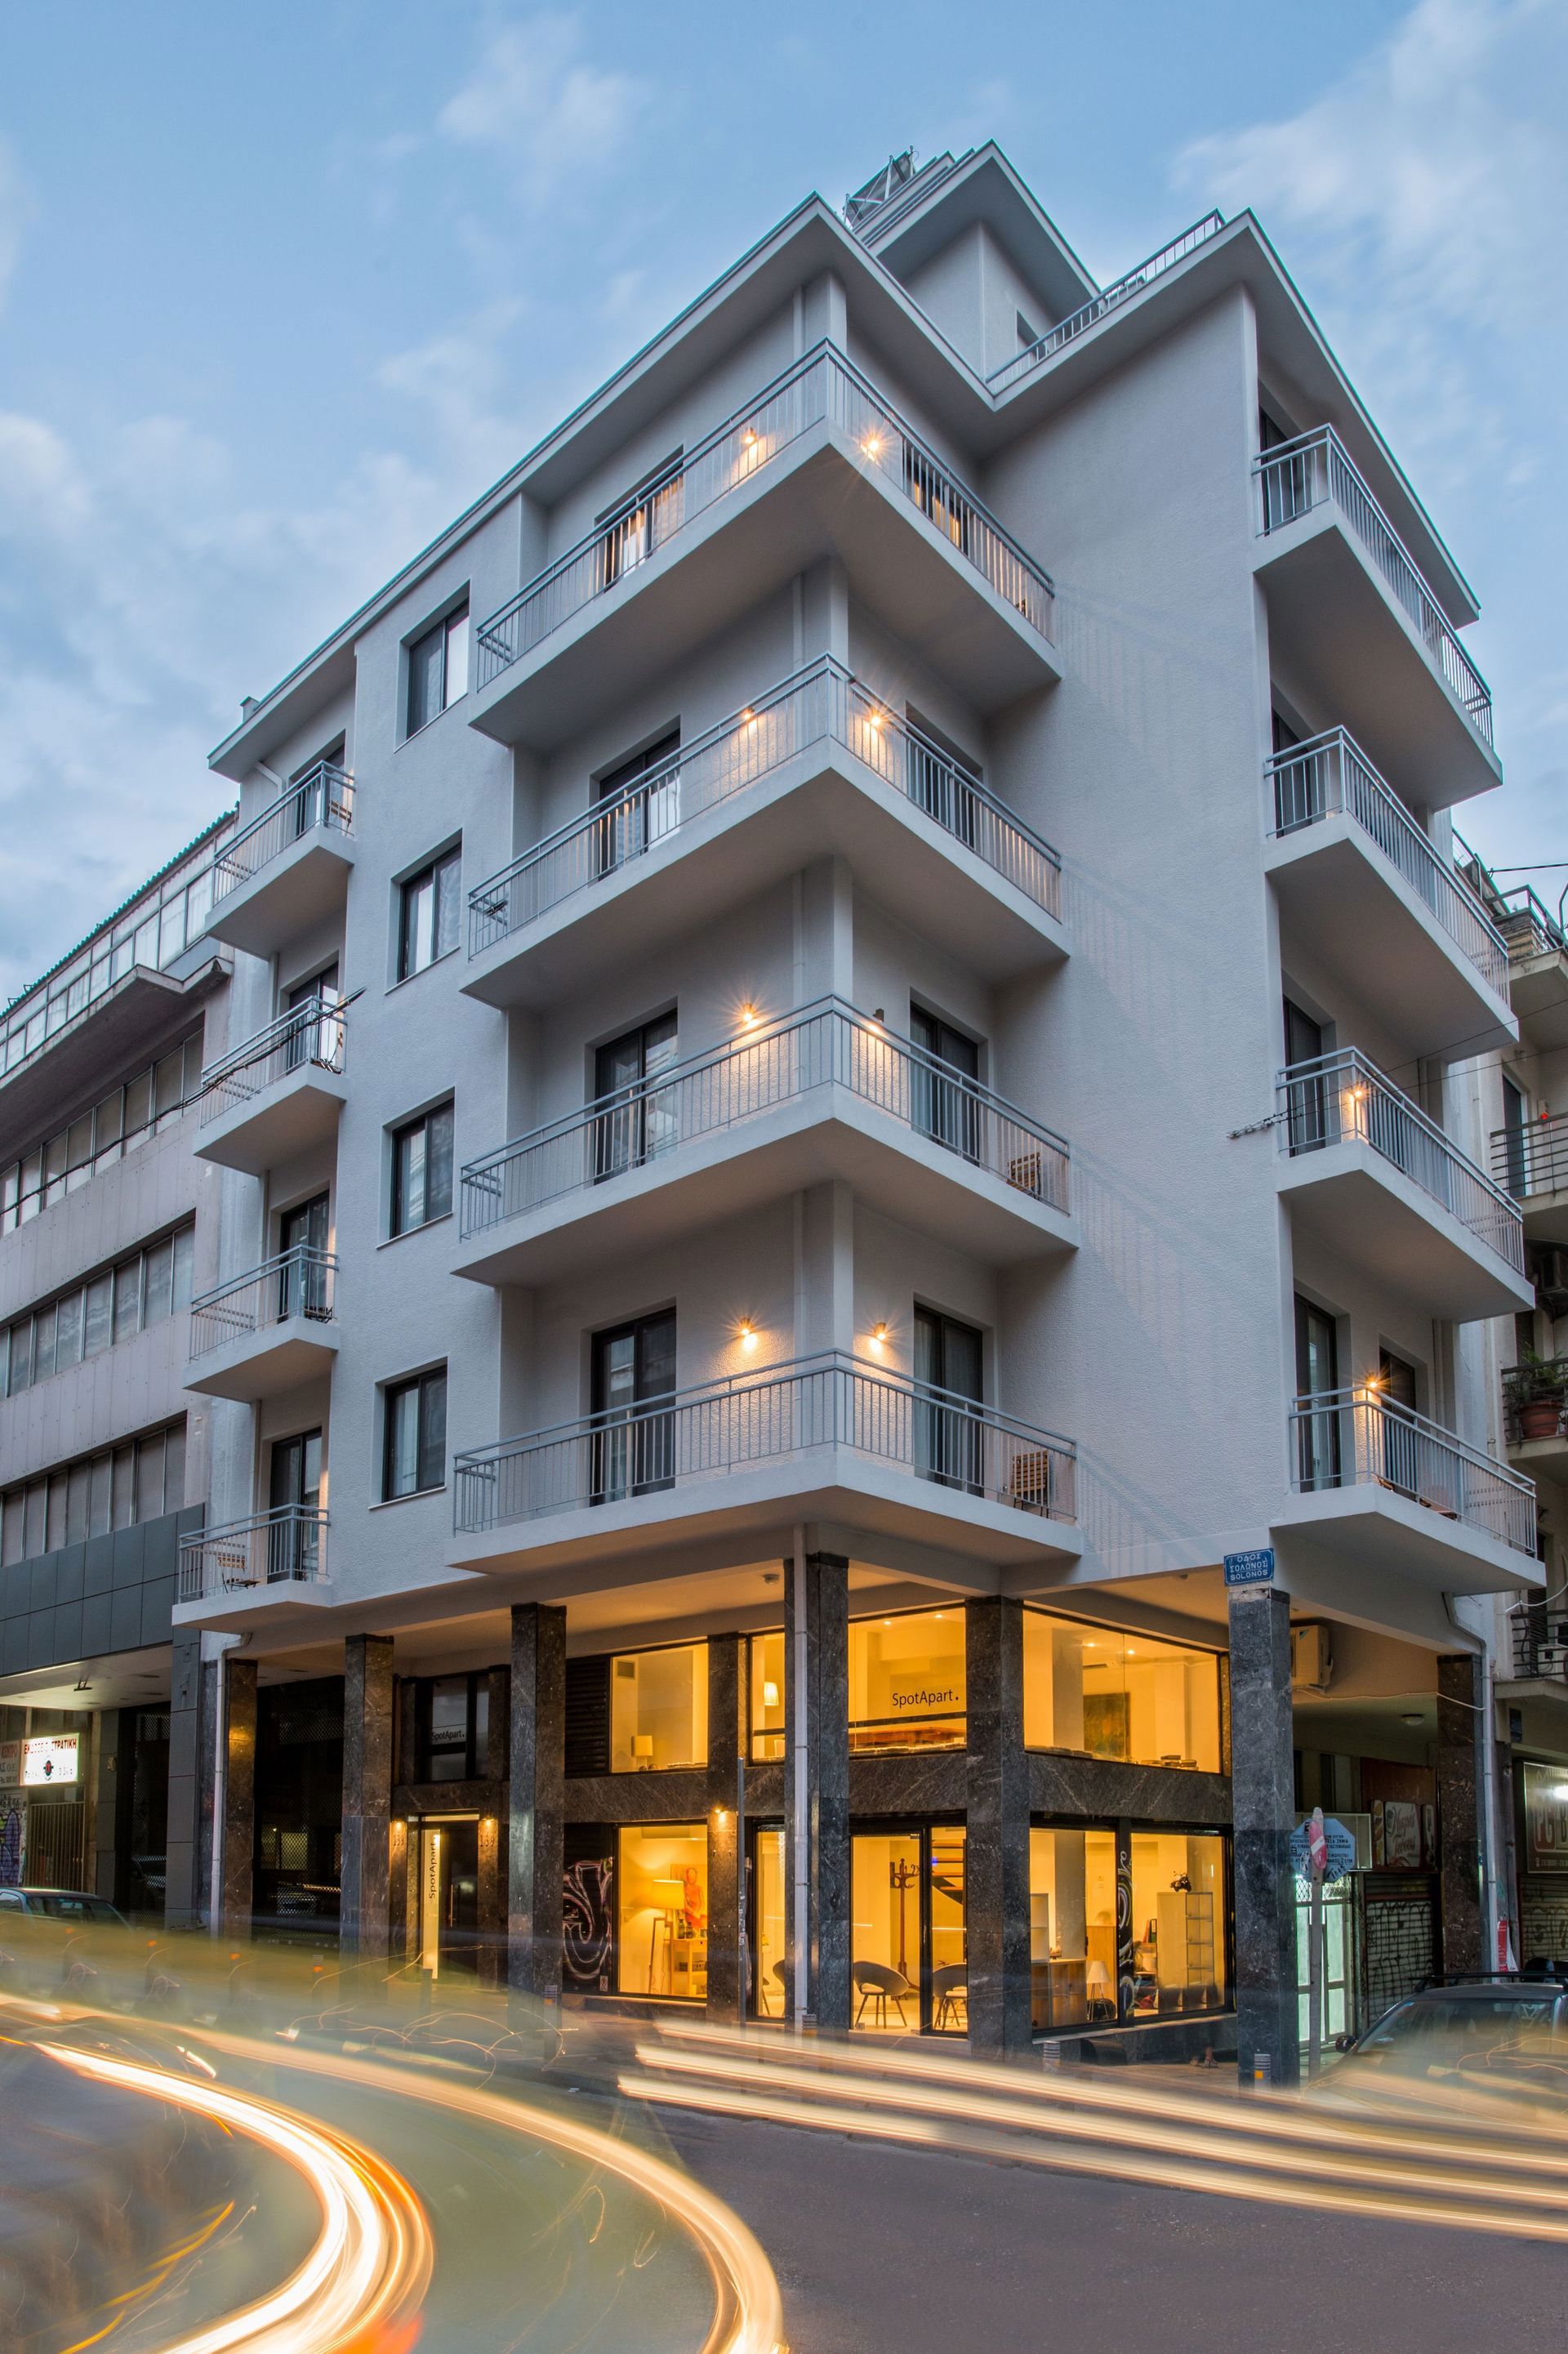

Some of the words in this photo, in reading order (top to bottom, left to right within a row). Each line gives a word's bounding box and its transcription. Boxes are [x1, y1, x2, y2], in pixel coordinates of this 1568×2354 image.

[1236, 1553, 1262, 1563] ΟΔΟΣ
[1230, 1559, 1268, 1573] ΣΟΛΩΝΟΣ
[1230, 1569, 1268, 1580] SOLONOS
